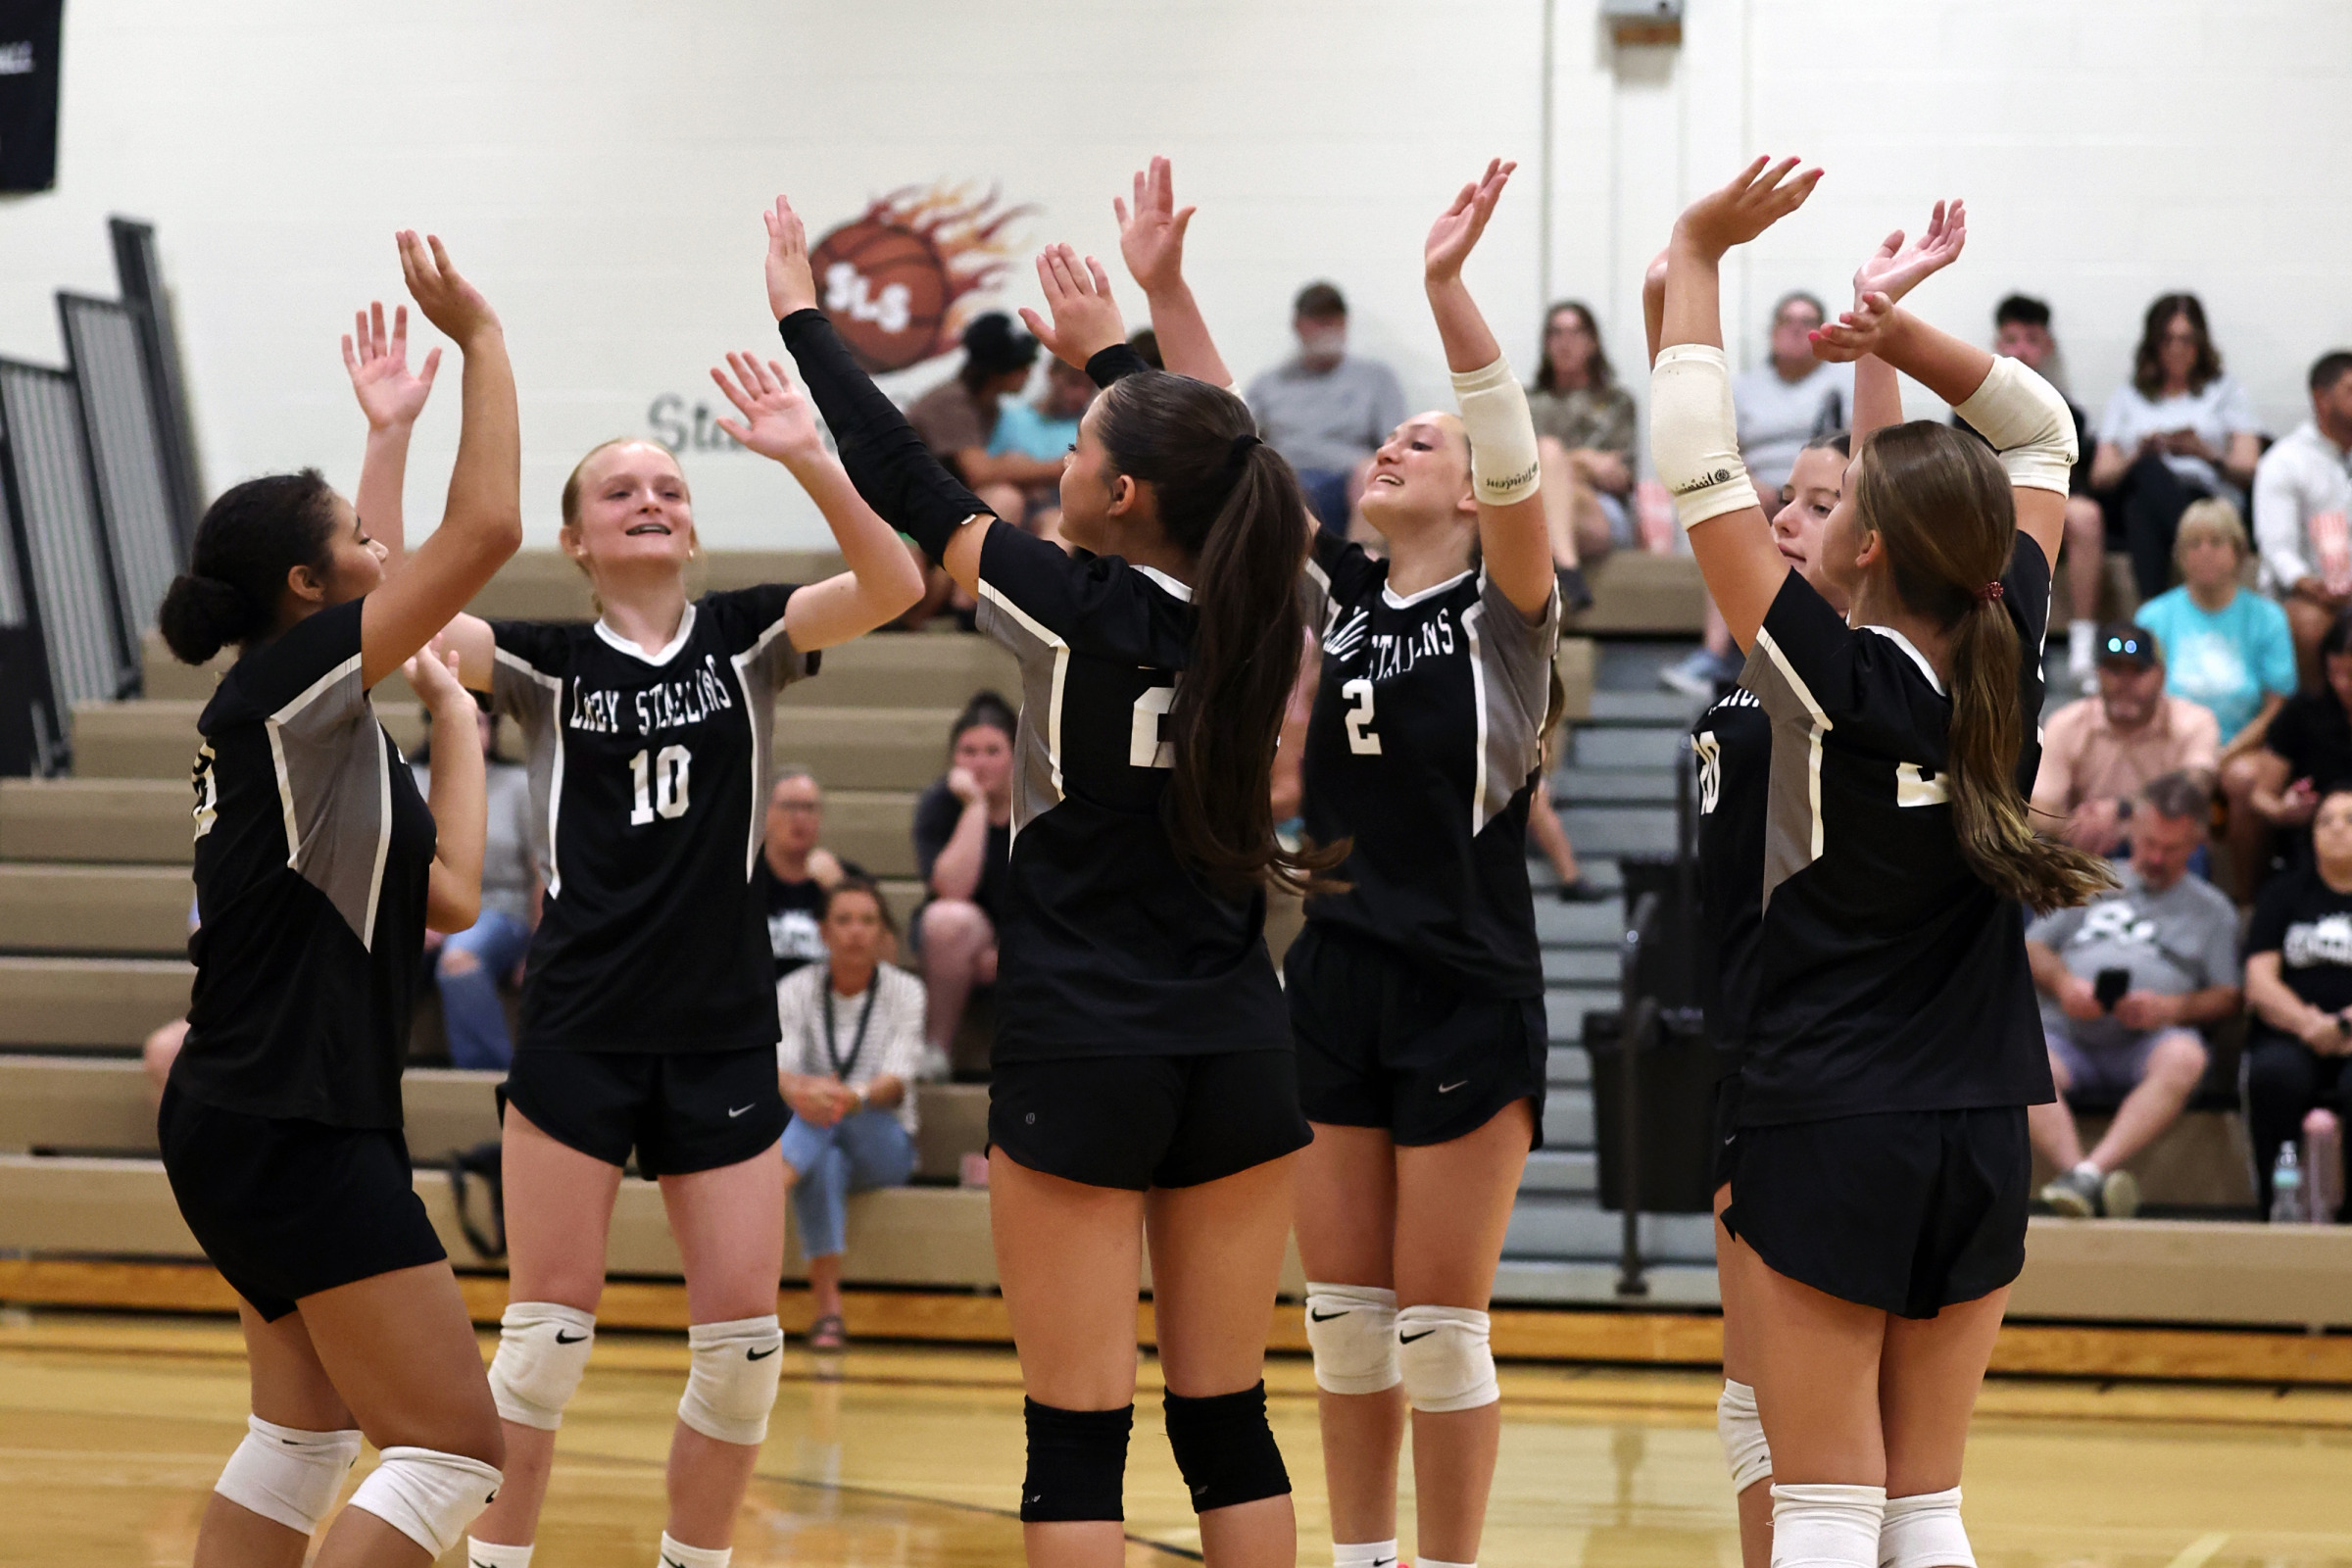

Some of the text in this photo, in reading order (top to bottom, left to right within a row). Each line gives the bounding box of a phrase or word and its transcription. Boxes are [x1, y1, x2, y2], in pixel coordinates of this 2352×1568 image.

[824, 261, 912, 334] SLS
[1342, 678, 1383, 756] 2
[629, 744, 692, 826] 10
